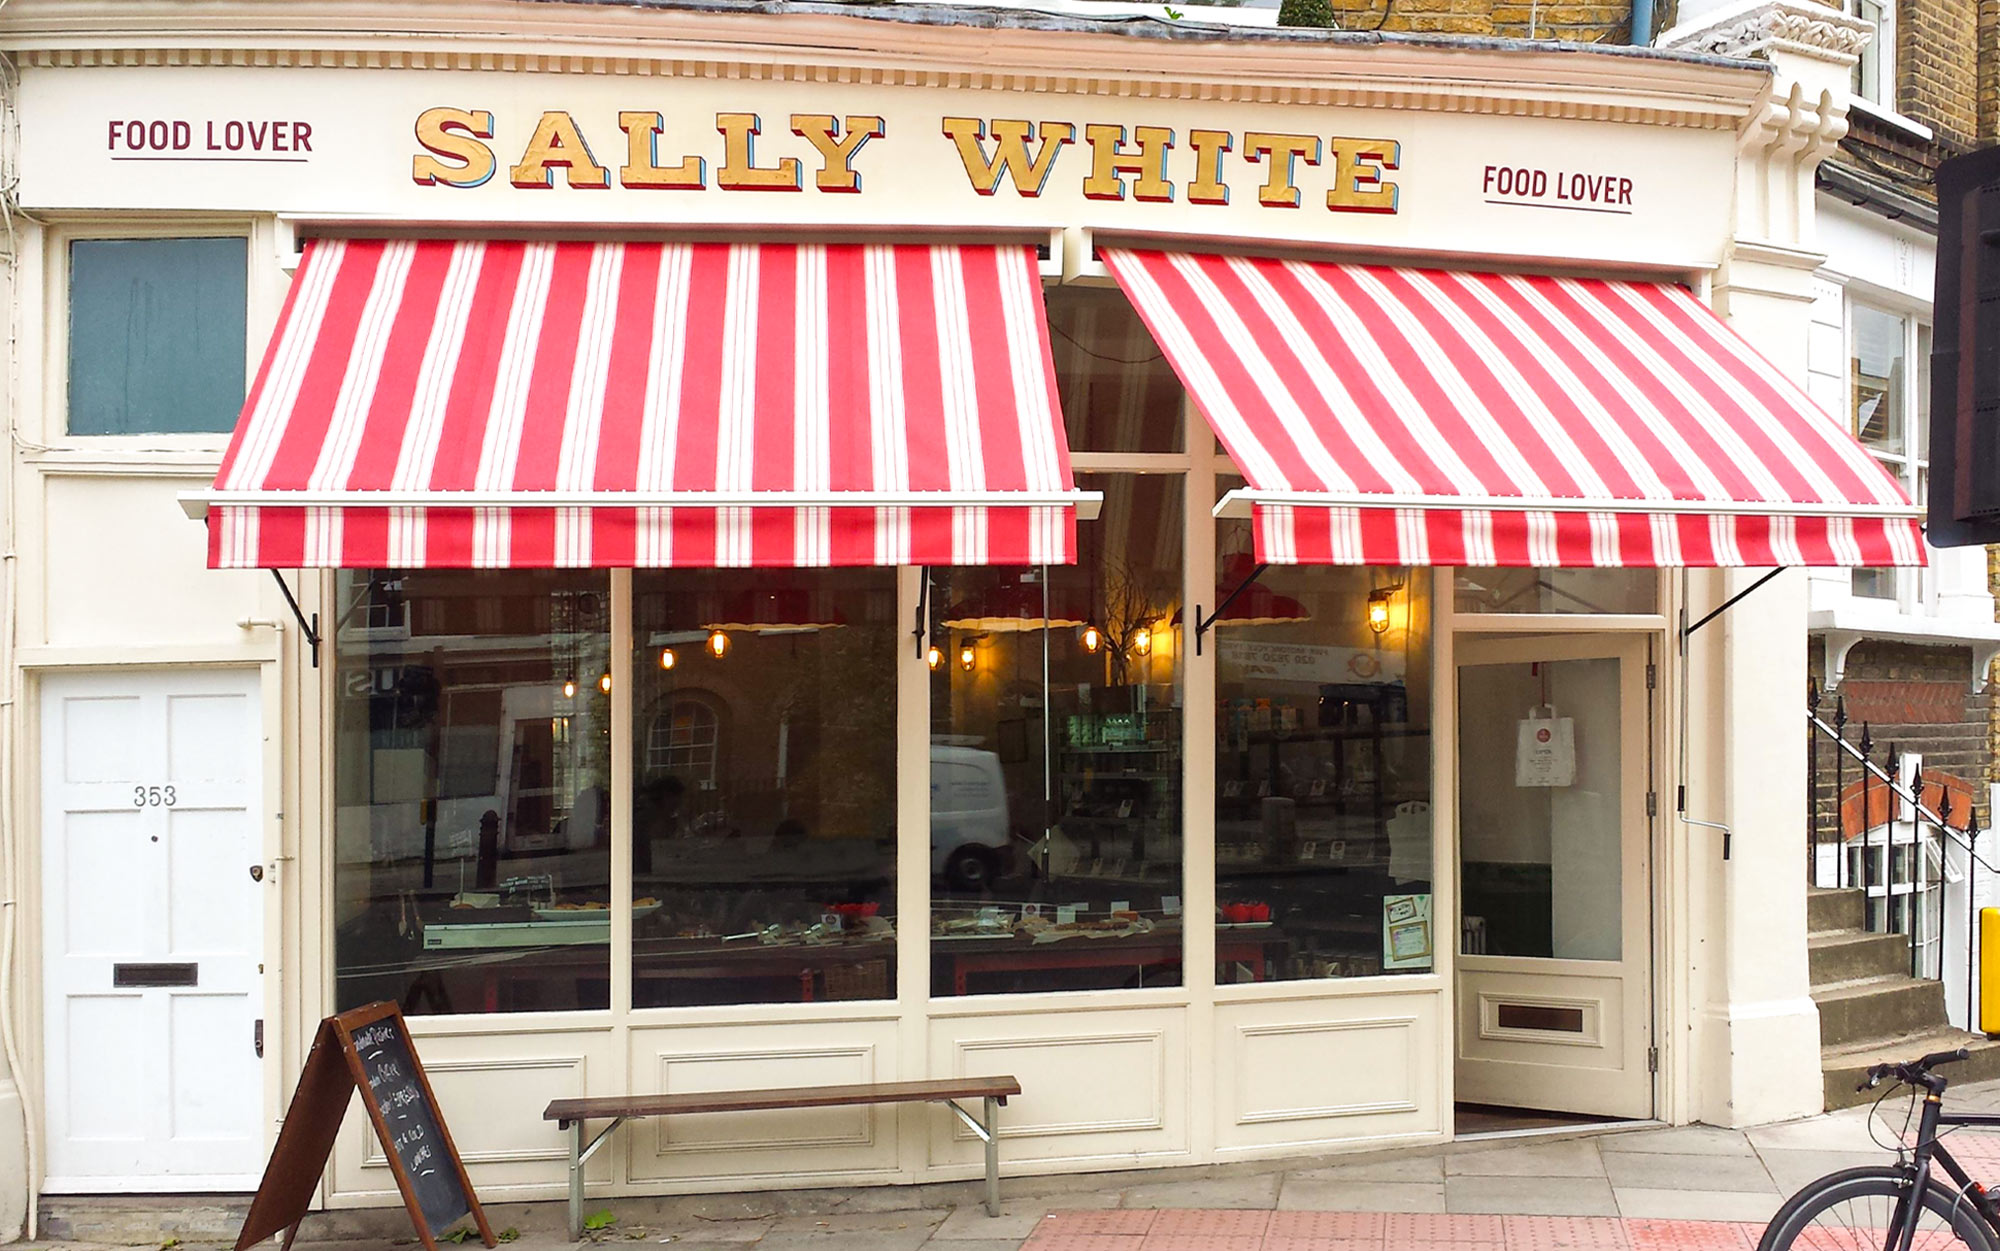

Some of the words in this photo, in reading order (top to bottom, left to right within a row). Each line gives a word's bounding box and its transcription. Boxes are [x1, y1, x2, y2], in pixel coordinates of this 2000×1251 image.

[108, 120, 191, 151] FOOD
[206, 121, 313, 152] LOVER
[412, 107, 885, 193] SALLY
[942, 117, 1400, 214] WHITE
[1483, 165, 1547, 198] FOOD
[1557, 172, 1633, 206] LOVER
[134, 785, 177, 807] 353
